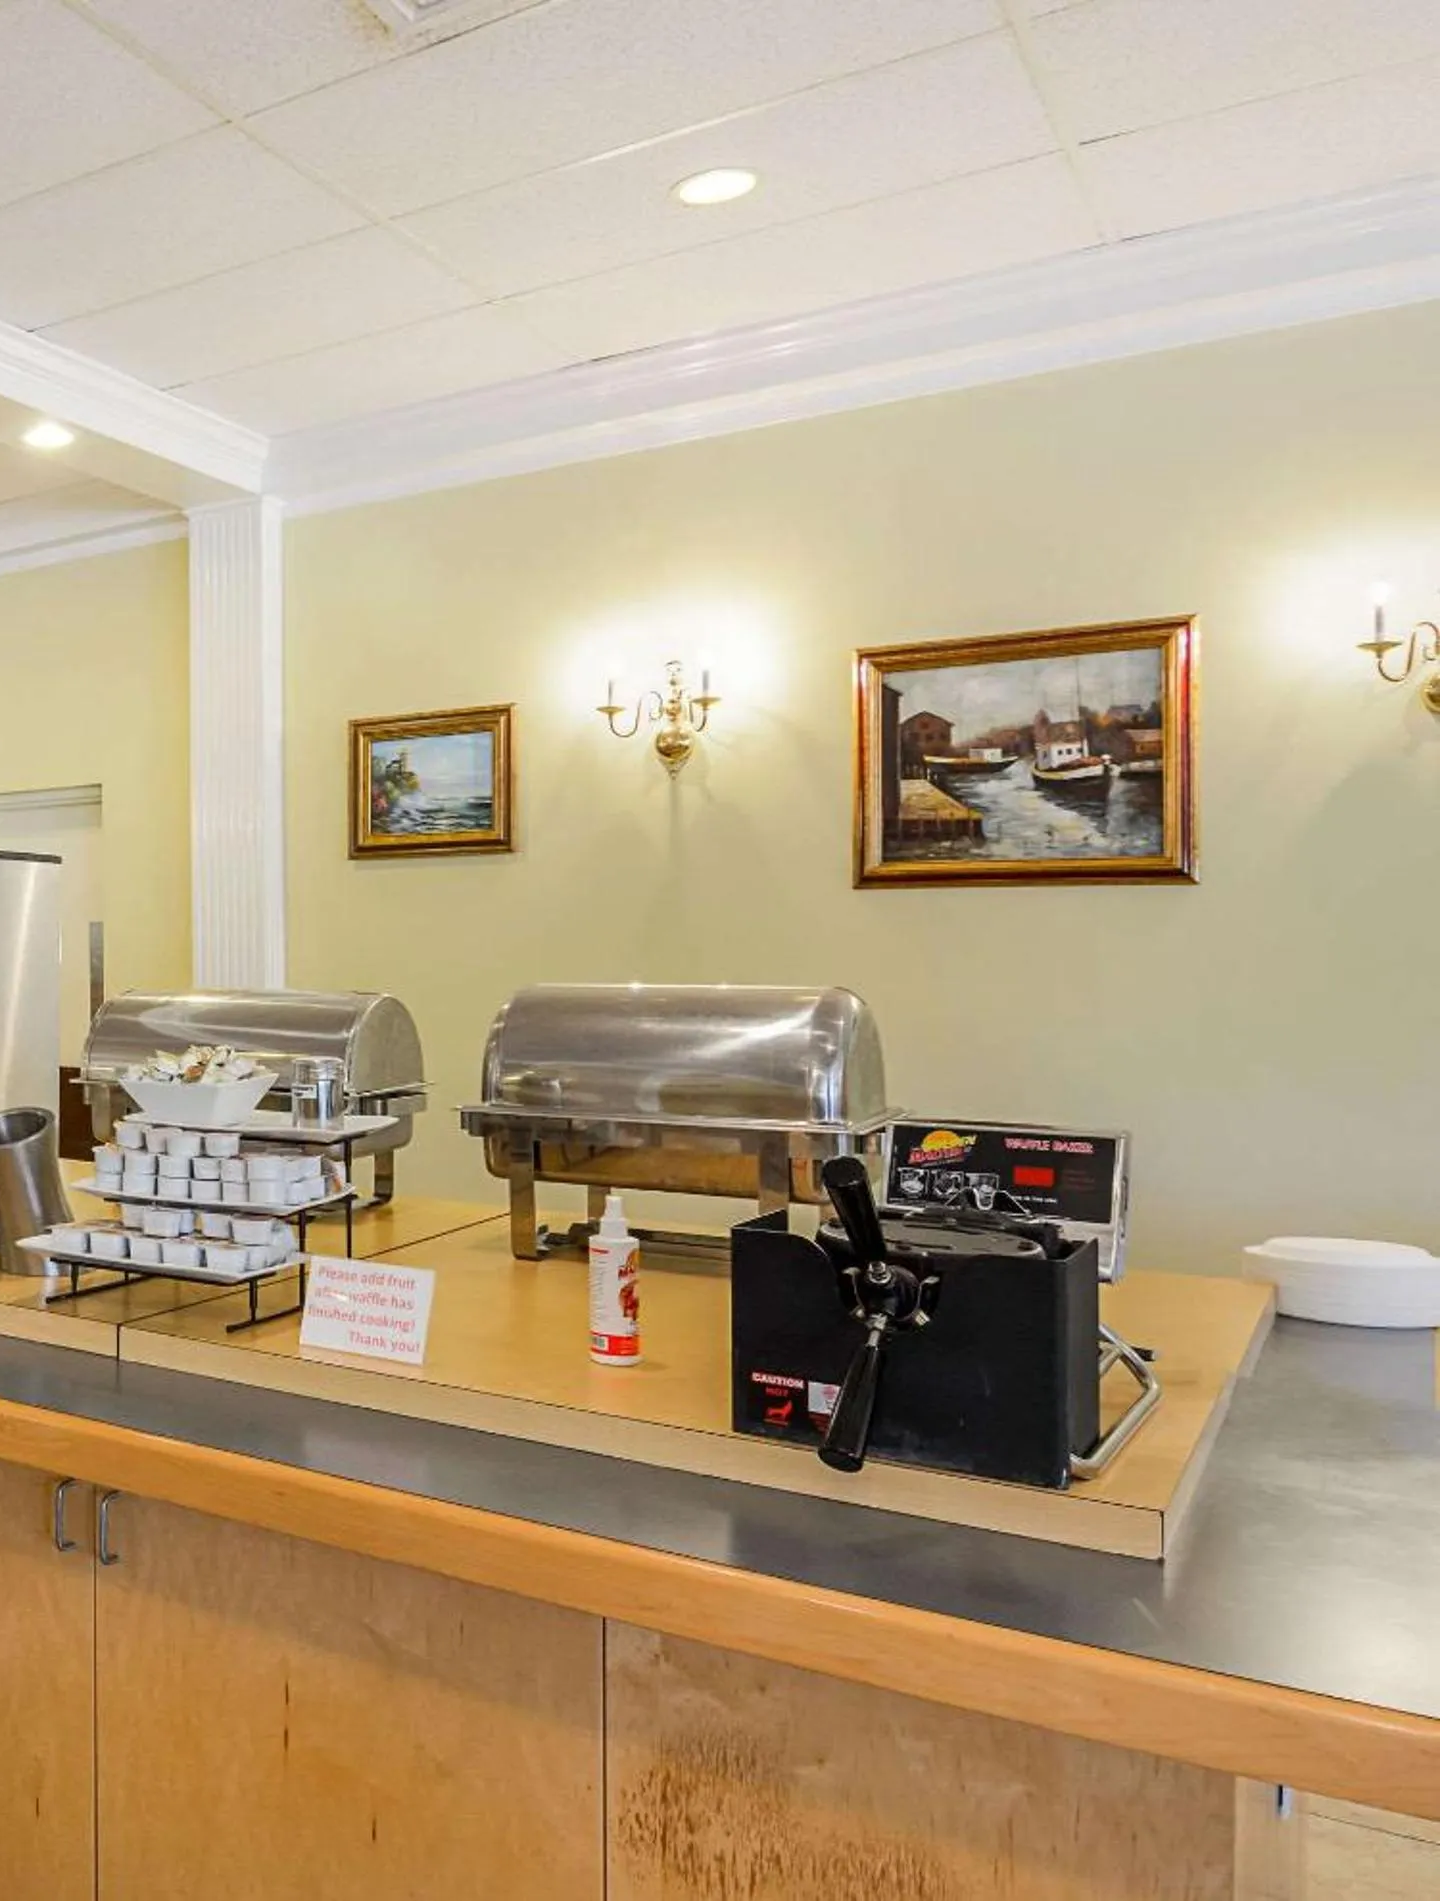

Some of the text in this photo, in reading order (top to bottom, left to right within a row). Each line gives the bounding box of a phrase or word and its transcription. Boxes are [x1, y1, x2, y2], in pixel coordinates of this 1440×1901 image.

[1004, 1138, 1051, 1151] WAFFLE
[318, 1265, 416, 1291] Please add fruit
[349, 1292, 388, 1306] waffle
[391, 1296, 414, 1310] has
[308, 1304, 357, 1322] finished
[349, 1331, 421, 1353] Thank you!
[752, 1372, 804, 1389] CAUTION
